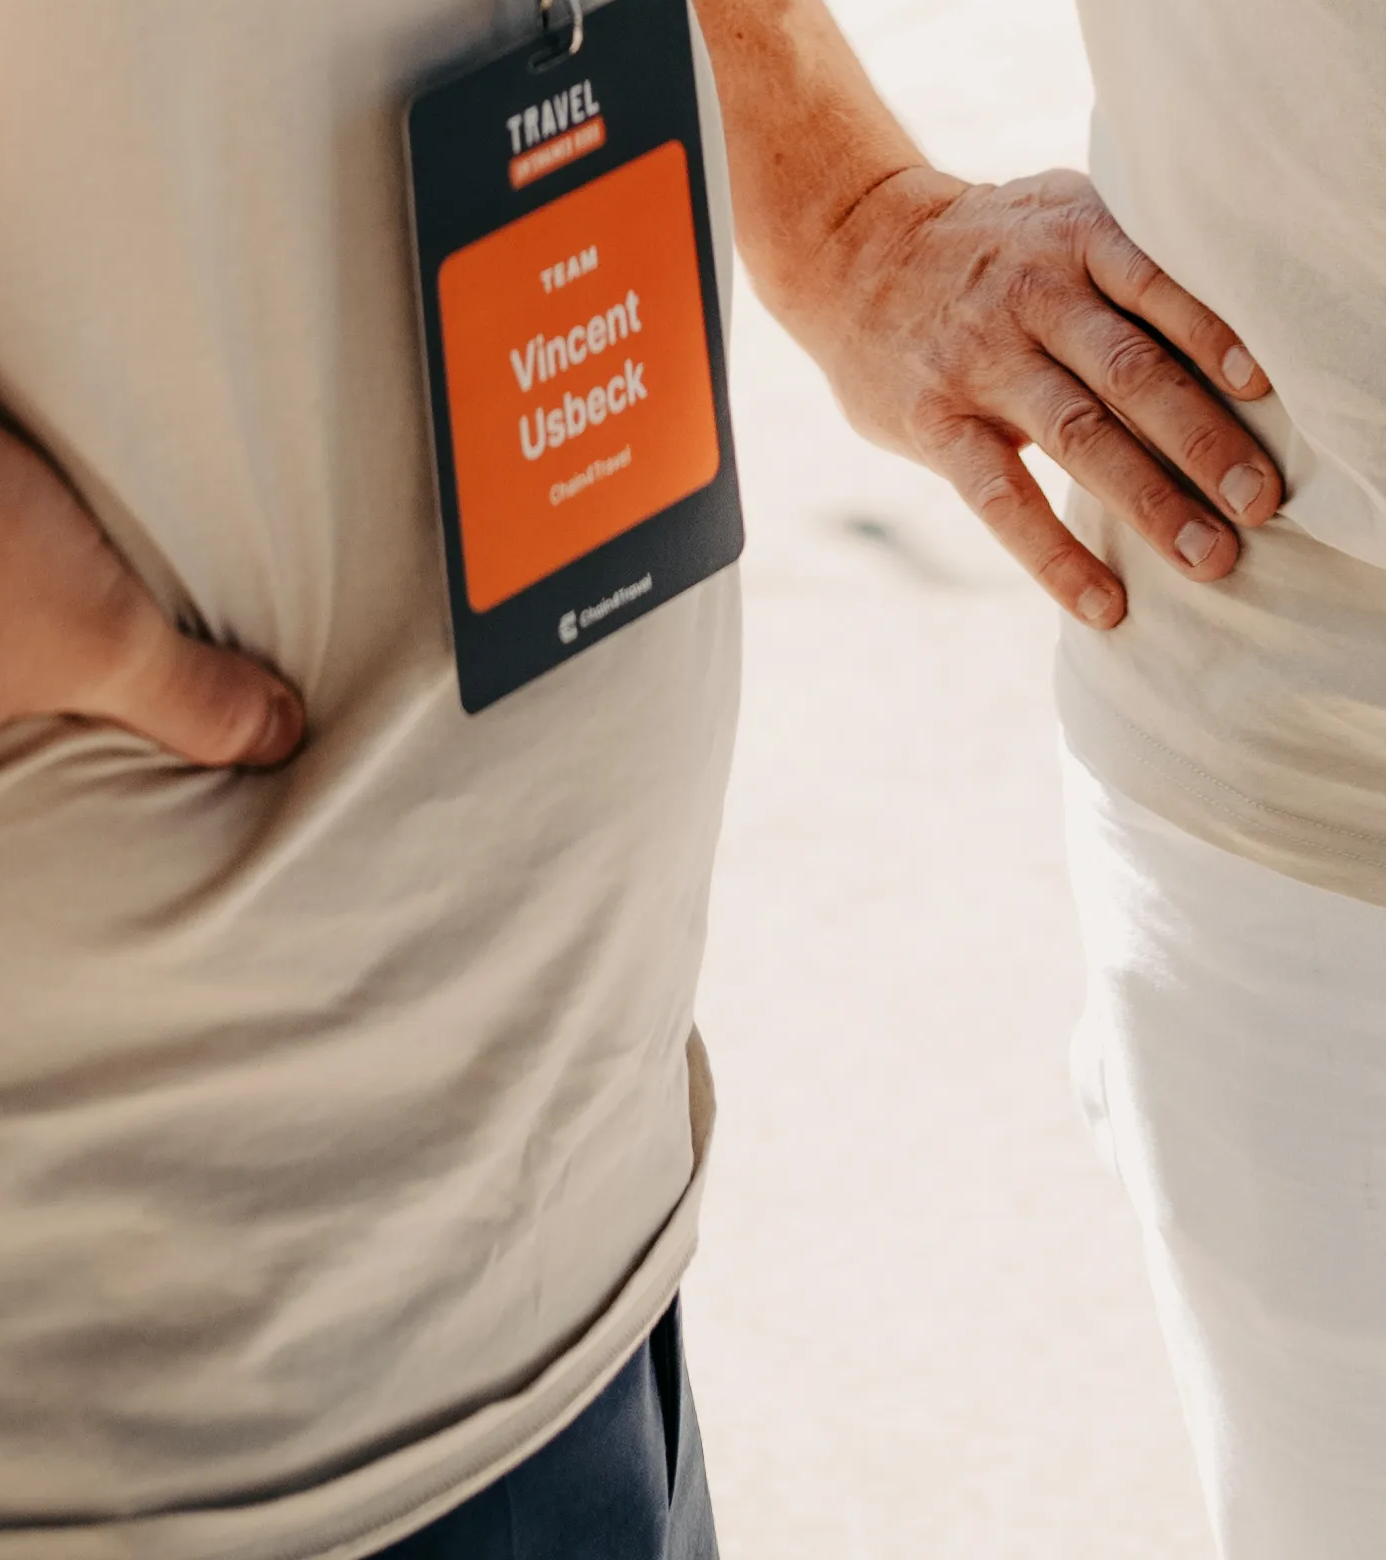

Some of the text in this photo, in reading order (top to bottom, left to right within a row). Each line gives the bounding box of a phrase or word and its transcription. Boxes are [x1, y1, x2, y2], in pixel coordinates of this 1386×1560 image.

[506, 79, 600, 154] TRAVEL
[539, 244, 598, 294] TEAM
[510, 289, 642, 393] Vincent
[519, 358, 648, 461] Usbeck
